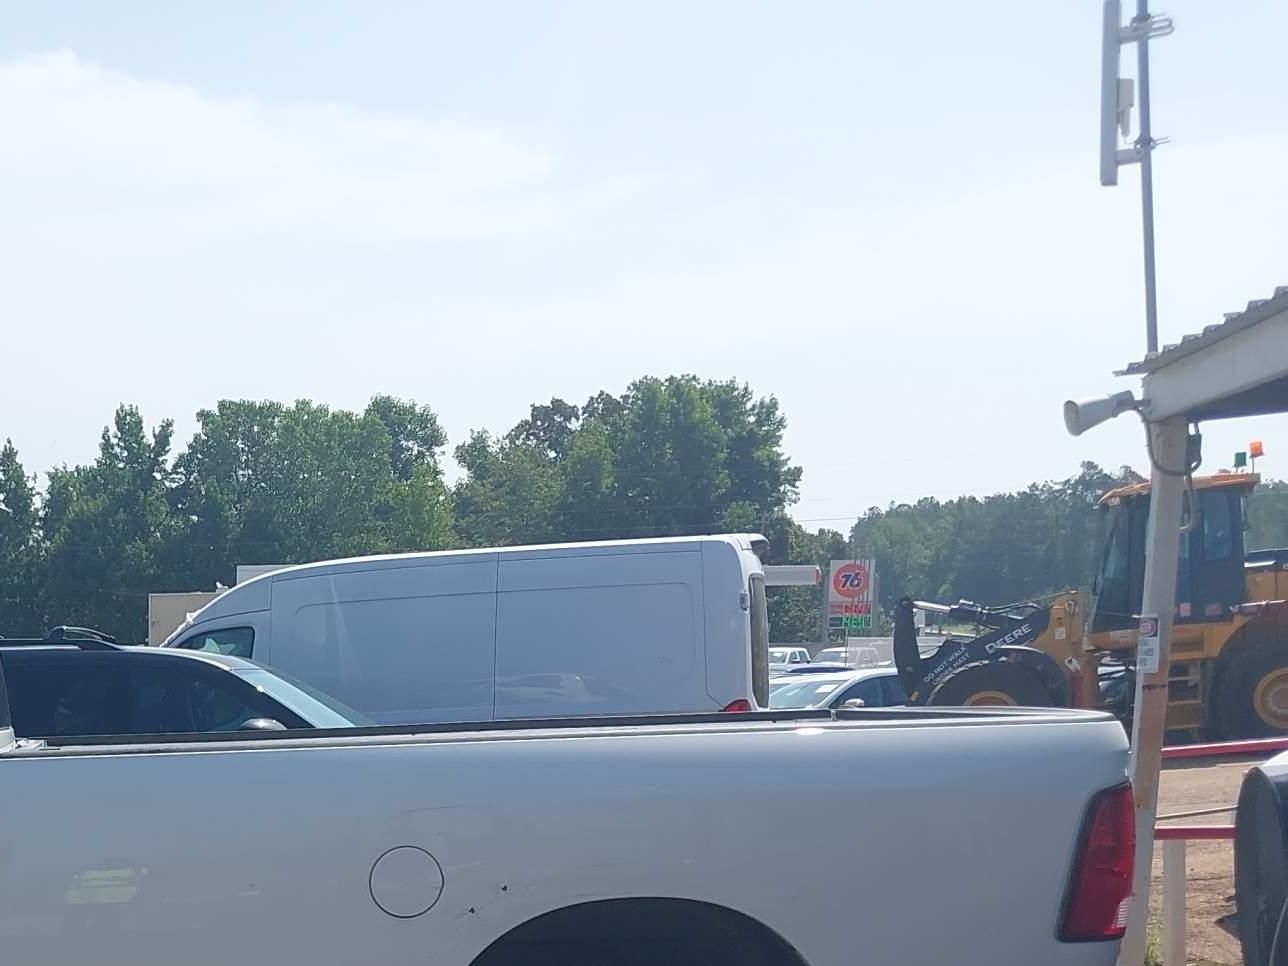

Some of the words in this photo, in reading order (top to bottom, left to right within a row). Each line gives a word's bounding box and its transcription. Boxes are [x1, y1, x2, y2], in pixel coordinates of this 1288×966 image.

[839, 571, 864, 590] 76
[985, 623, 1033, 654] DEERE
[923, 673, 935, 683] DO
[934, 660, 948, 674] NOT
[948, 643, 968, 663] WALK
[953, 652, 970, 669] MAST
